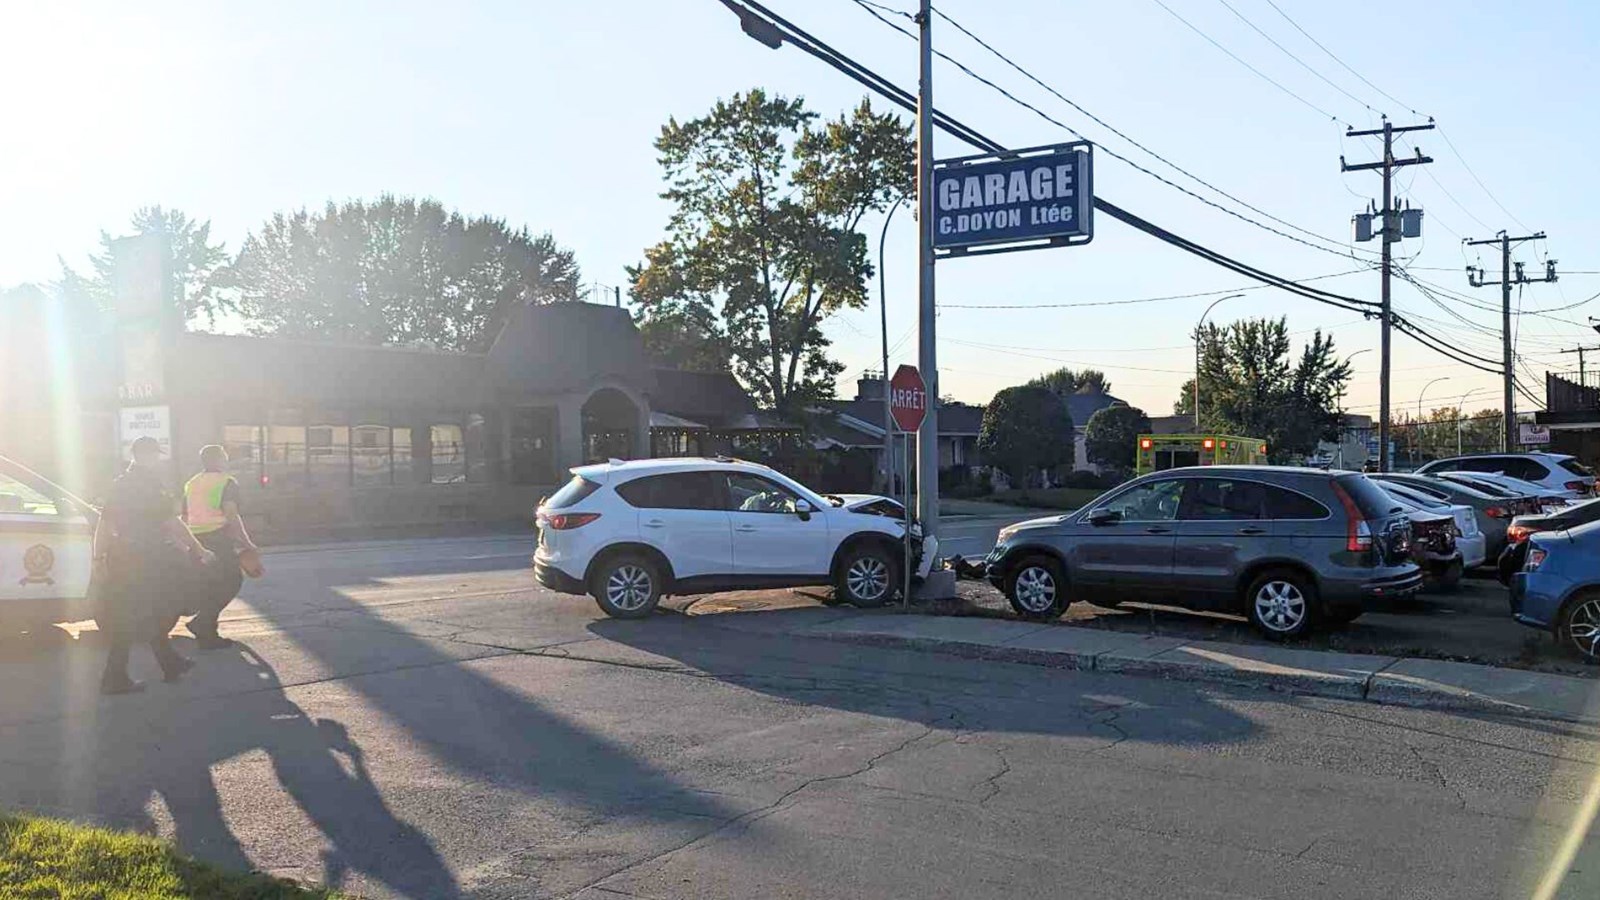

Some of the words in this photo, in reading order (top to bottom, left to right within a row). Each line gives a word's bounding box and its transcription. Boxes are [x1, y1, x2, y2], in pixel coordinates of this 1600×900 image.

[939, 164, 1073, 211] GARAGE
[939, 208, 1021, 234] C.DOYON
[1031, 203, 1073, 225] Ltée
[891, 387, 925, 410] ARRÊT
